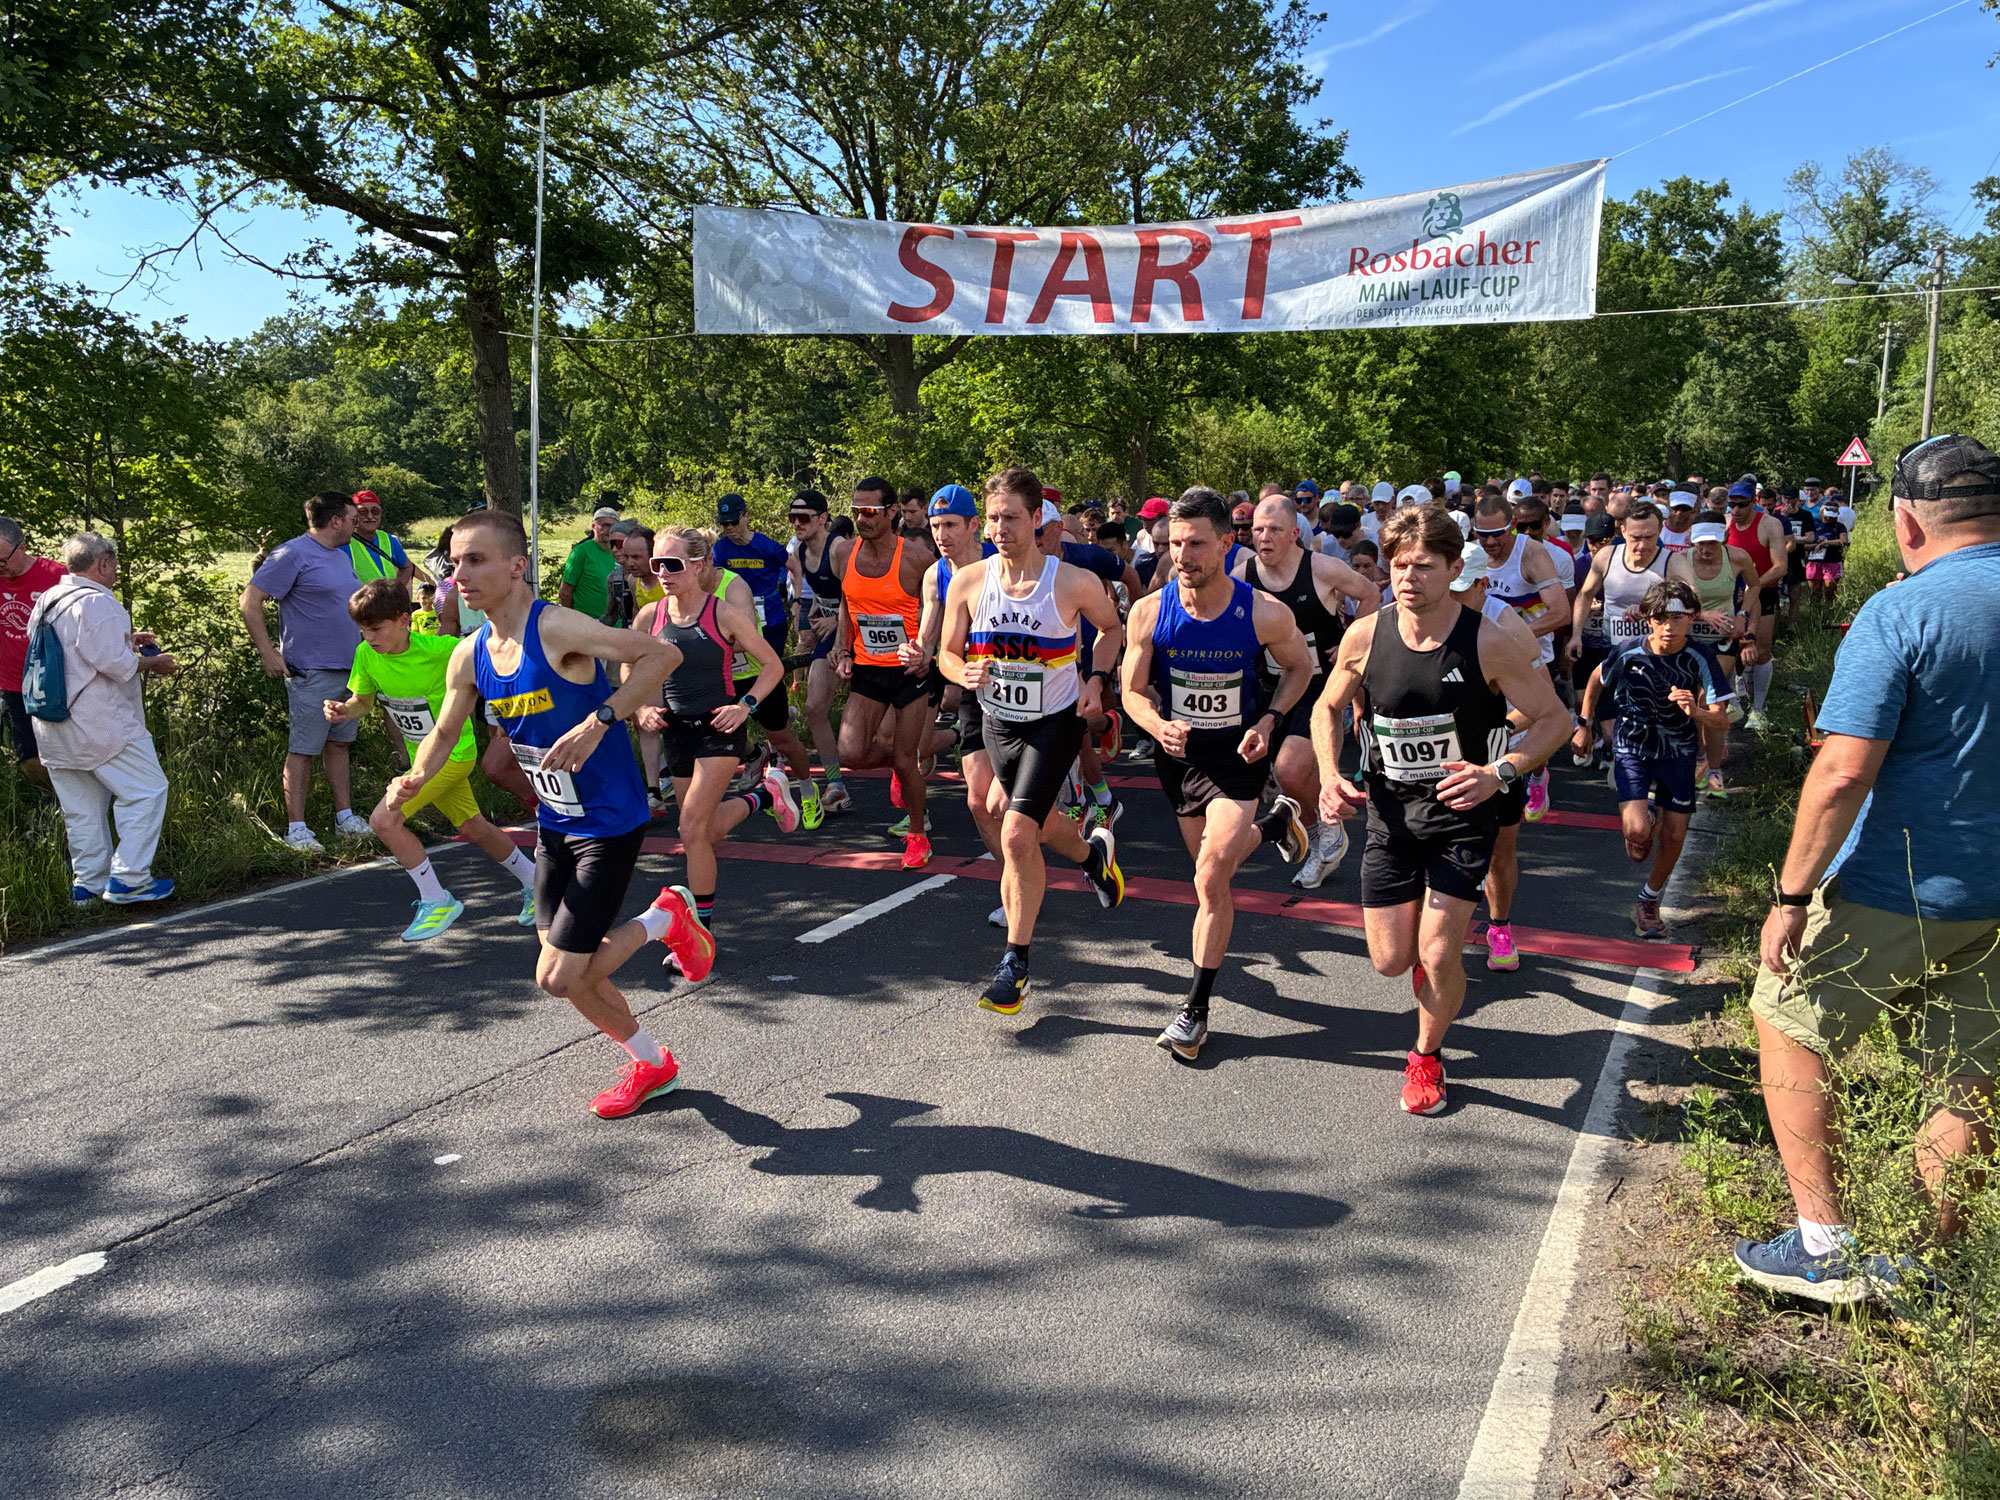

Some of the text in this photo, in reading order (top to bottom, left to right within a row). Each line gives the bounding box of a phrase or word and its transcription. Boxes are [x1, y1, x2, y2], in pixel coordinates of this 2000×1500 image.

[1346, 230, 1541, 276] Rosbacher
[887, 215, 1303, 324] START
[1358, 275, 1521, 303] MAIN-LAUF-CUP
[1356, 302, 1511, 318] DER STADT FRANKFURT AM MAIN
[989, 612, 1042, 631] HANAU
[868, 630, 898, 644] 966
[992, 635, 1038, 661] SSC
[1180, 649, 1244, 659] SPIRIDON
[1191, 673, 1229, 681] Rosbacher
[992, 682, 1028, 706] 210
[1183, 694, 1228, 713] 403
[393, 712, 424, 731] 935
[999, 709, 1029, 721] mainova
[1192, 719, 1228, 727] mainova
[1386, 738, 1450, 763] 1097
[523, 768, 562, 796] 710
[1410, 769, 1451, 779] mainova
